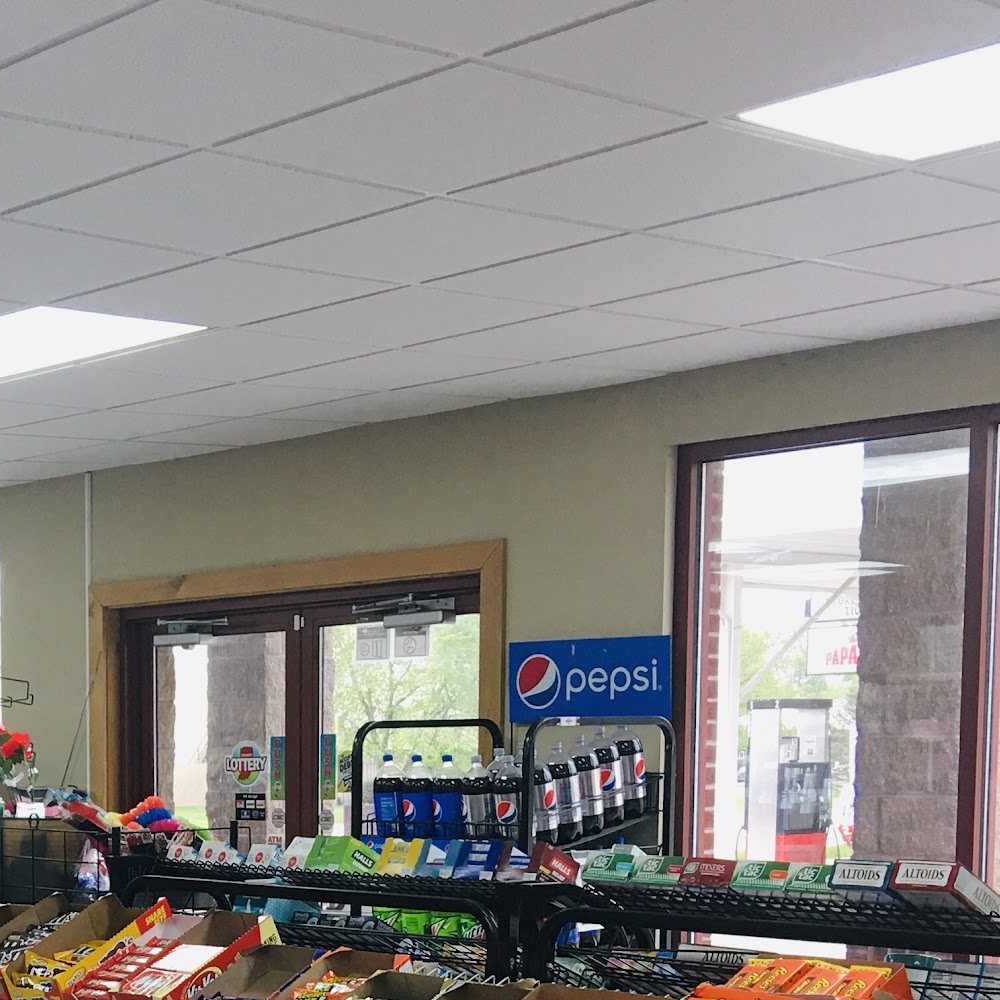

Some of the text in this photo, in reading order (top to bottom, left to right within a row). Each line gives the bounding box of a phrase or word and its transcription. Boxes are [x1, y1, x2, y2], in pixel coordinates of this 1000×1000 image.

[566, 659, 658, 701] pepsi
[226, 757, 266, 771] LOTTERY
[354, 851, 373, 868] HALLS
[552, 858, 571, 874] HALLS
[839, 869, 881, 880] ALTOIDS
[902, 868, 945, 880] ALTOIDS
[145, 905, 165, 926] SHARE
